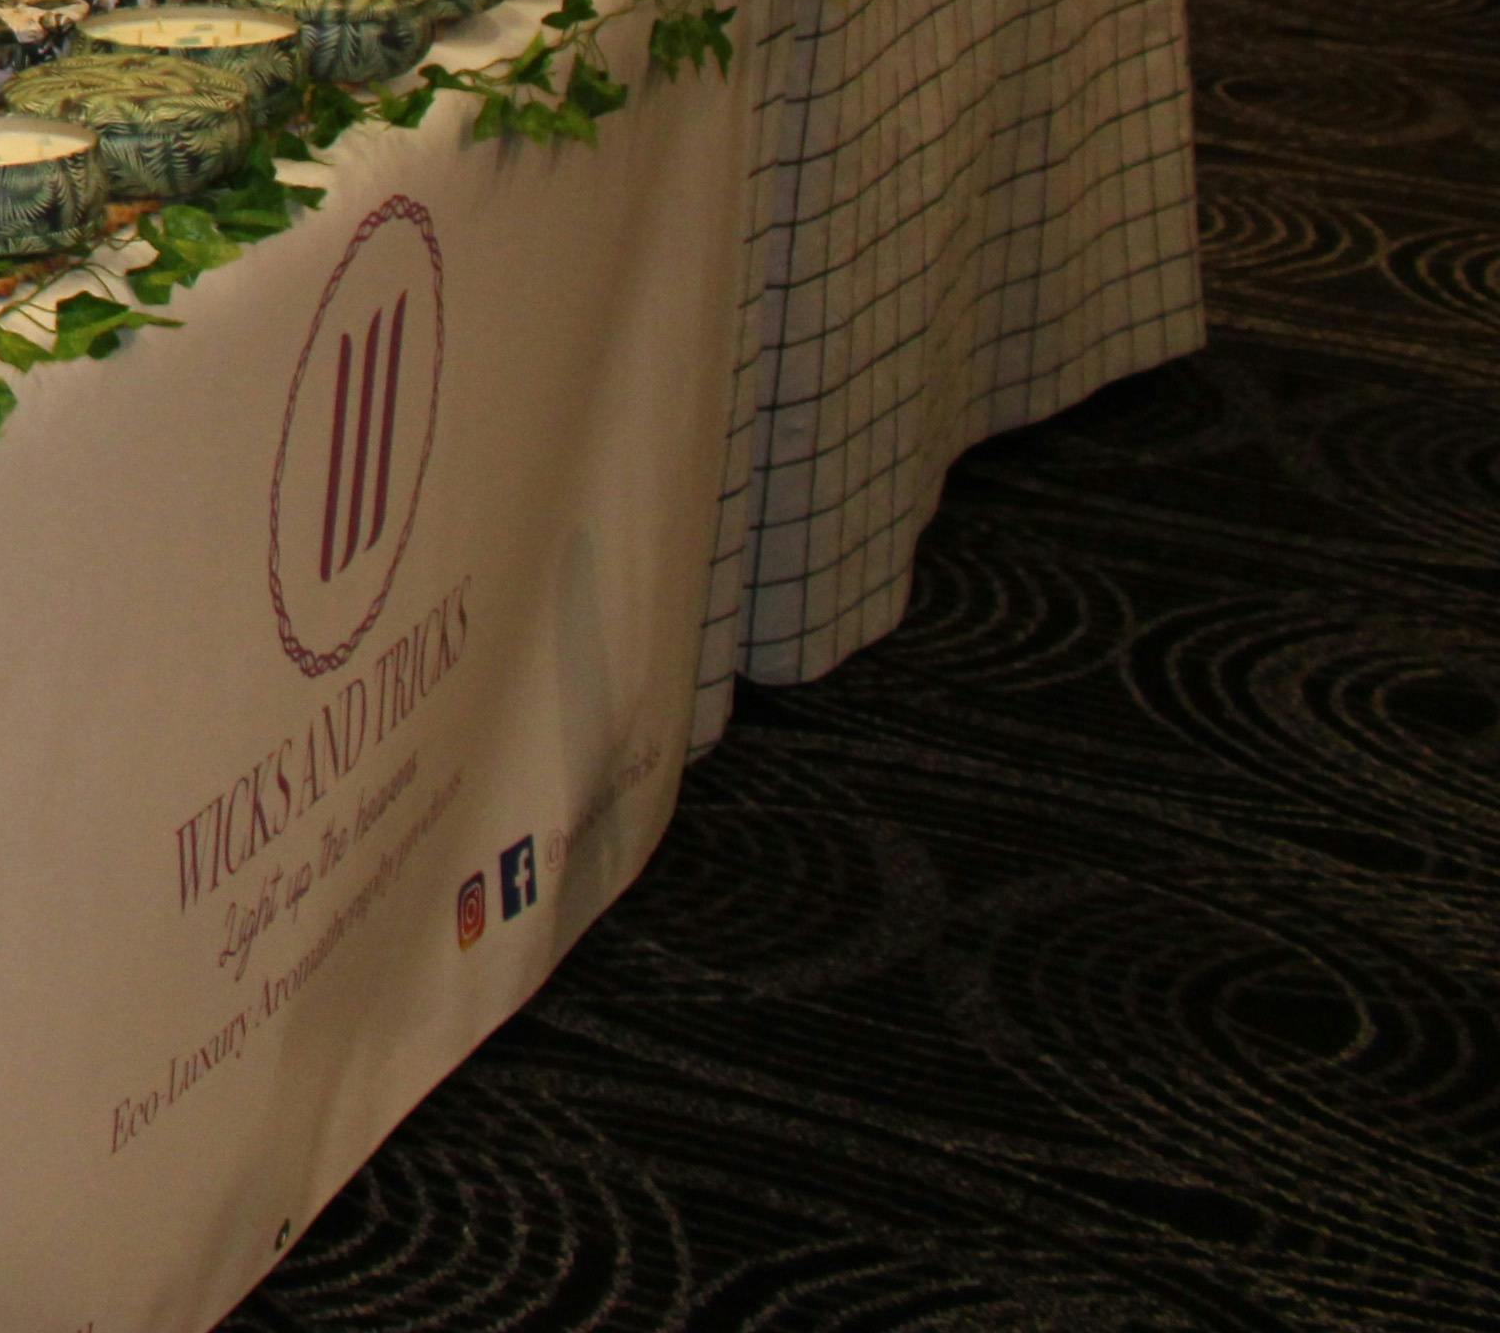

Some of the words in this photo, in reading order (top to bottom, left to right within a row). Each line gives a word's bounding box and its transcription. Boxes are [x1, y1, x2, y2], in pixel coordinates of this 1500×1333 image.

[175, 737, 293, 916] WICKS
[297, 678, 367, 819] AND
[374, 574, 471, 746] TRICKS
[217, 863, 285, 983] Light
[285, 861, 313, 924] up
